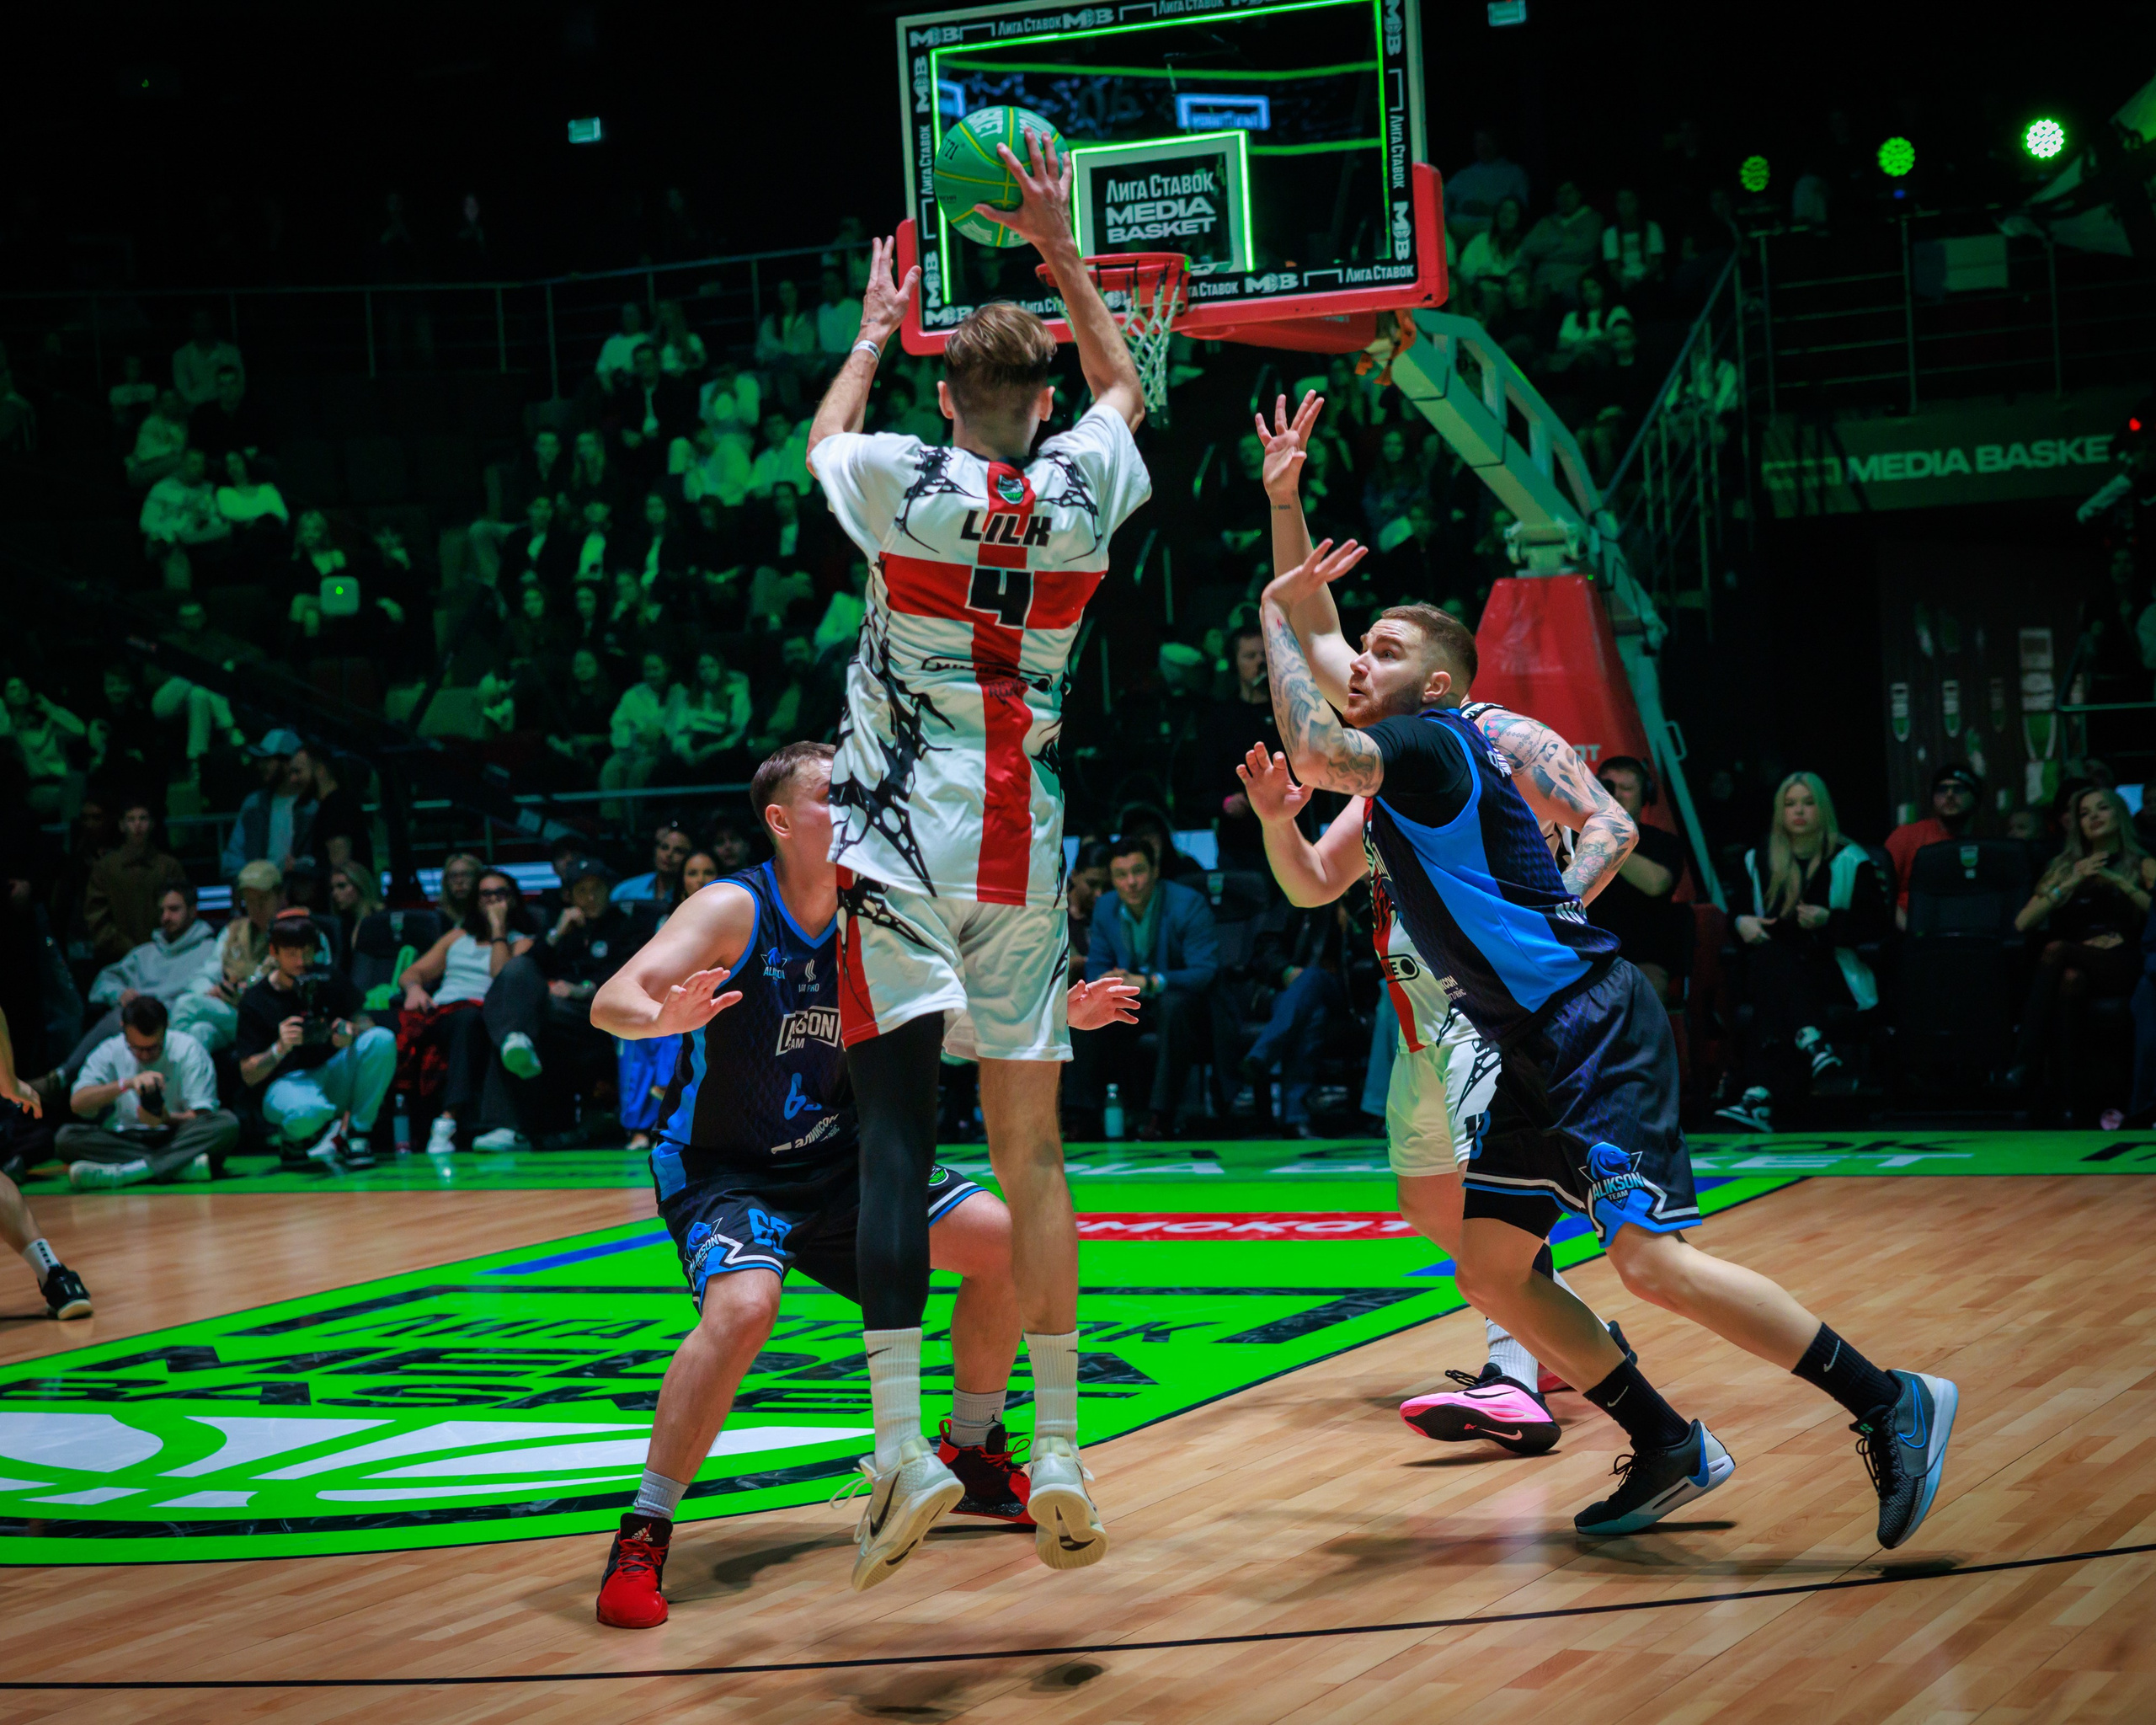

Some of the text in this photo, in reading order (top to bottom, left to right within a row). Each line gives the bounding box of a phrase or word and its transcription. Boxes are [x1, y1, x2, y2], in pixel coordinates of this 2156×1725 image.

[1105, 195, 1216, 227] MEDIA
[1107, 216, 1218, 244] BASKET
[1848, 447, 1972, 483] MEDIA
[1976, 434, 2115, 473] BASKE
[965, 566, 1034, 630] 4
[1592, 1172, 1646, 1201] ALIKSON
[1608, 1190, 1629, 1200] TEAM
